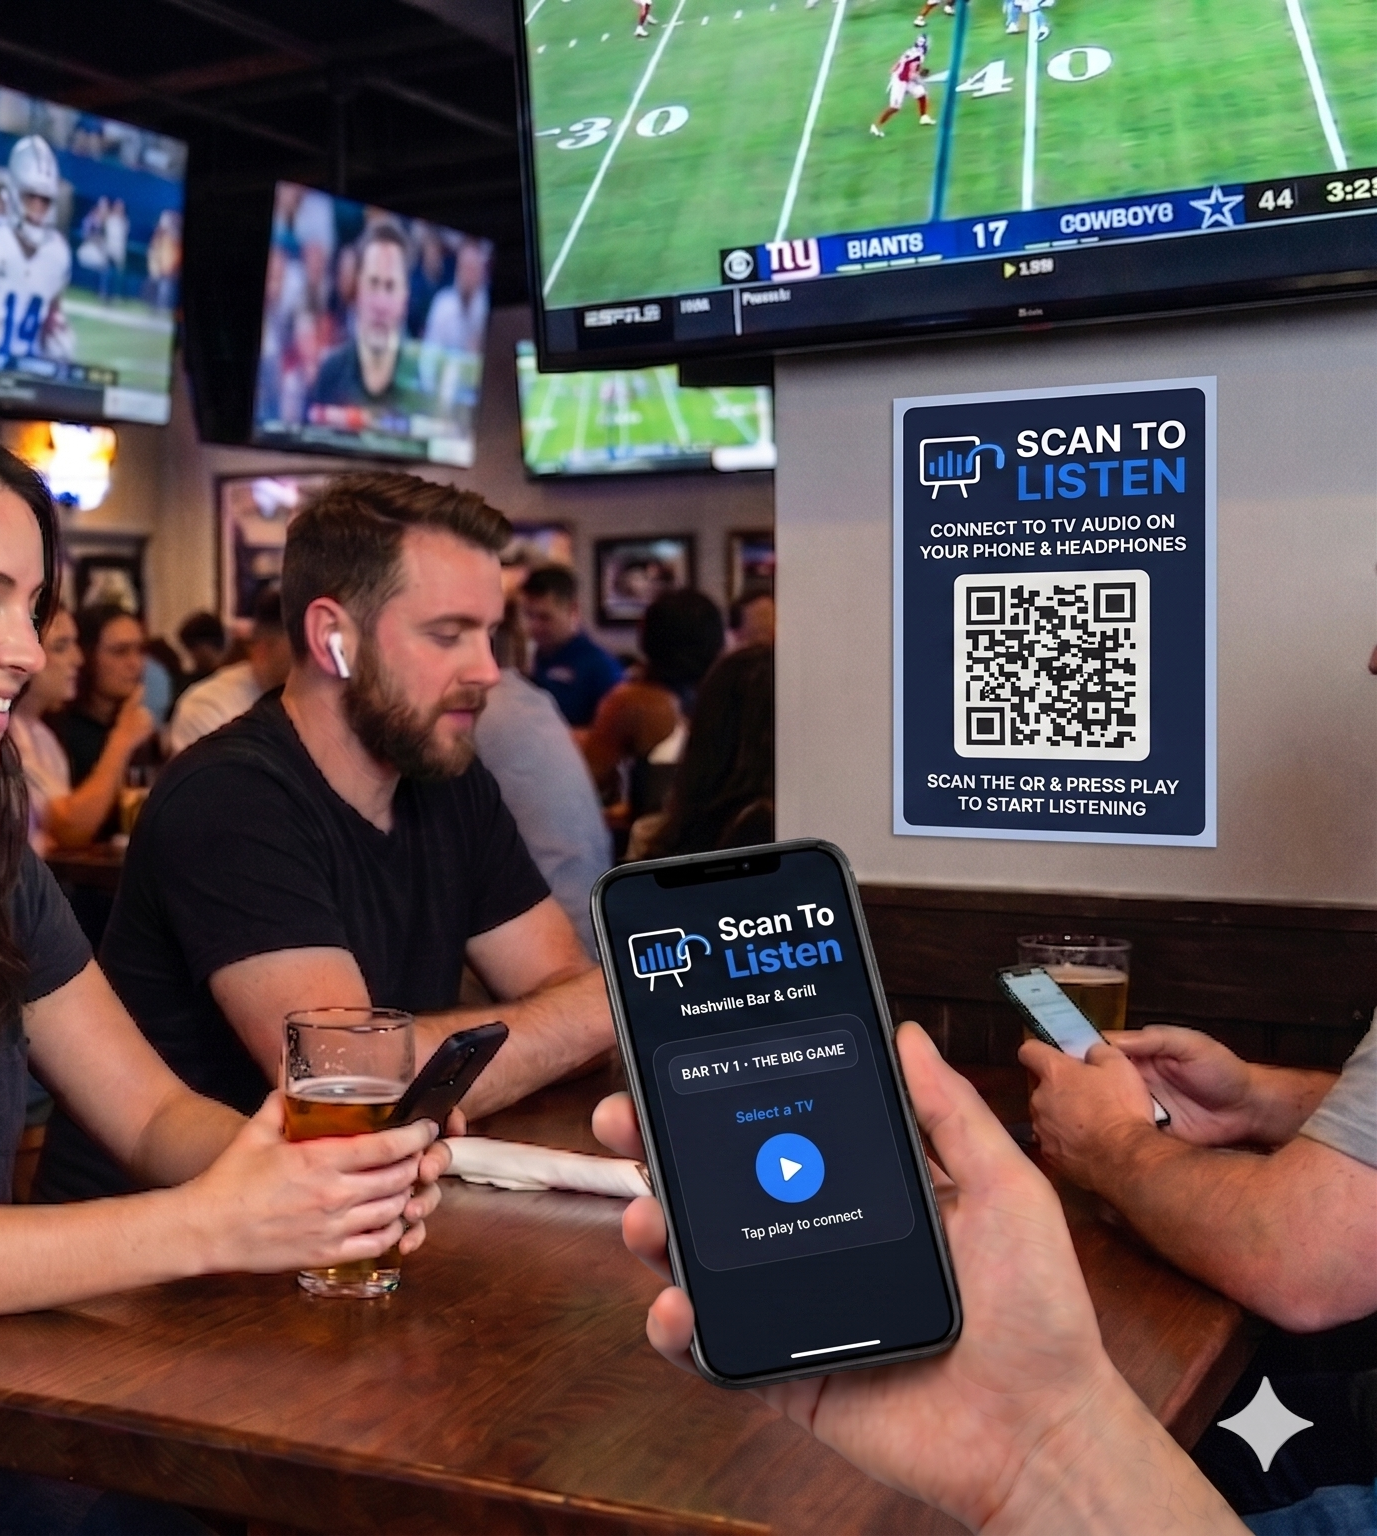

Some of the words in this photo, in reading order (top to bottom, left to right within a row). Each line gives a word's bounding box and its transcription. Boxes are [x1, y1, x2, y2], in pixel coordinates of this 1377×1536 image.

[972, 220, 1009, 248] 17
[1258, 188, 1294, 211] 44
[1016, 424, 1121, 457] SCAN
[1132, 420, 1186, 450] TO
[1018, 457, 1185, 501] LISTEN
[930, 520, 1017, 537] CONNECT
[1022, 519, 1046, 534] TO
[1051, 518, 1076, 533] TV
[1081, 515, 1141, 532] AUDIO
[1146, 514, 1175, 529] ON
[920, 544, 969, 559] YOUR
[973, 542, 1035, 558] PHONE
[1039, 541, 1052, 556] &
[1057, 536, 1187, 555] HEADPHONES
[927, 774, 975, 789] SCAN
[980, 775, 1015, 790] THE
[1019, 776, 1045, 792] QR
[1049, 777, 1062, 791] &
[1067, 778, 1126, 793] PRESS
[1130, 779, 1179, 795] PLAY
[958, 796, 982, 811] TO
[986, 797, 1044, 813] START
[1049, 799, 1147, 816] LISTENING
[718, 912, 792, 941] Scan
[797, 903, 835, 928] To
[725, 938, 843, 979] Listen
[680, 996, 744, 1016] Nashville
[746, 992, 771, 1007] Bar
[774, 989, 784, 1002] &
[787, 984, 817, 1000] Grill
[681, 1065, 710, 1080] BAR
[711, 1061, 730, 1075] TV
[733, 1060, 740, 1072] 1
[752, 1054, 779, 1069] THE
[781, 1049, 804, 1064] BIG
[806, 1043, 845, 1059] GAME
[736, 1106, 780, 1124] Select
[783, 1105, 792, 1116] a
[795, 1099, 814, 1113] TV
[742, 1226, 766, 1240] Tap
[768, 1220, 794, 1238] play
[797, 1218, 810, 1230] to
[813, 1208, 863, 1228] connect
